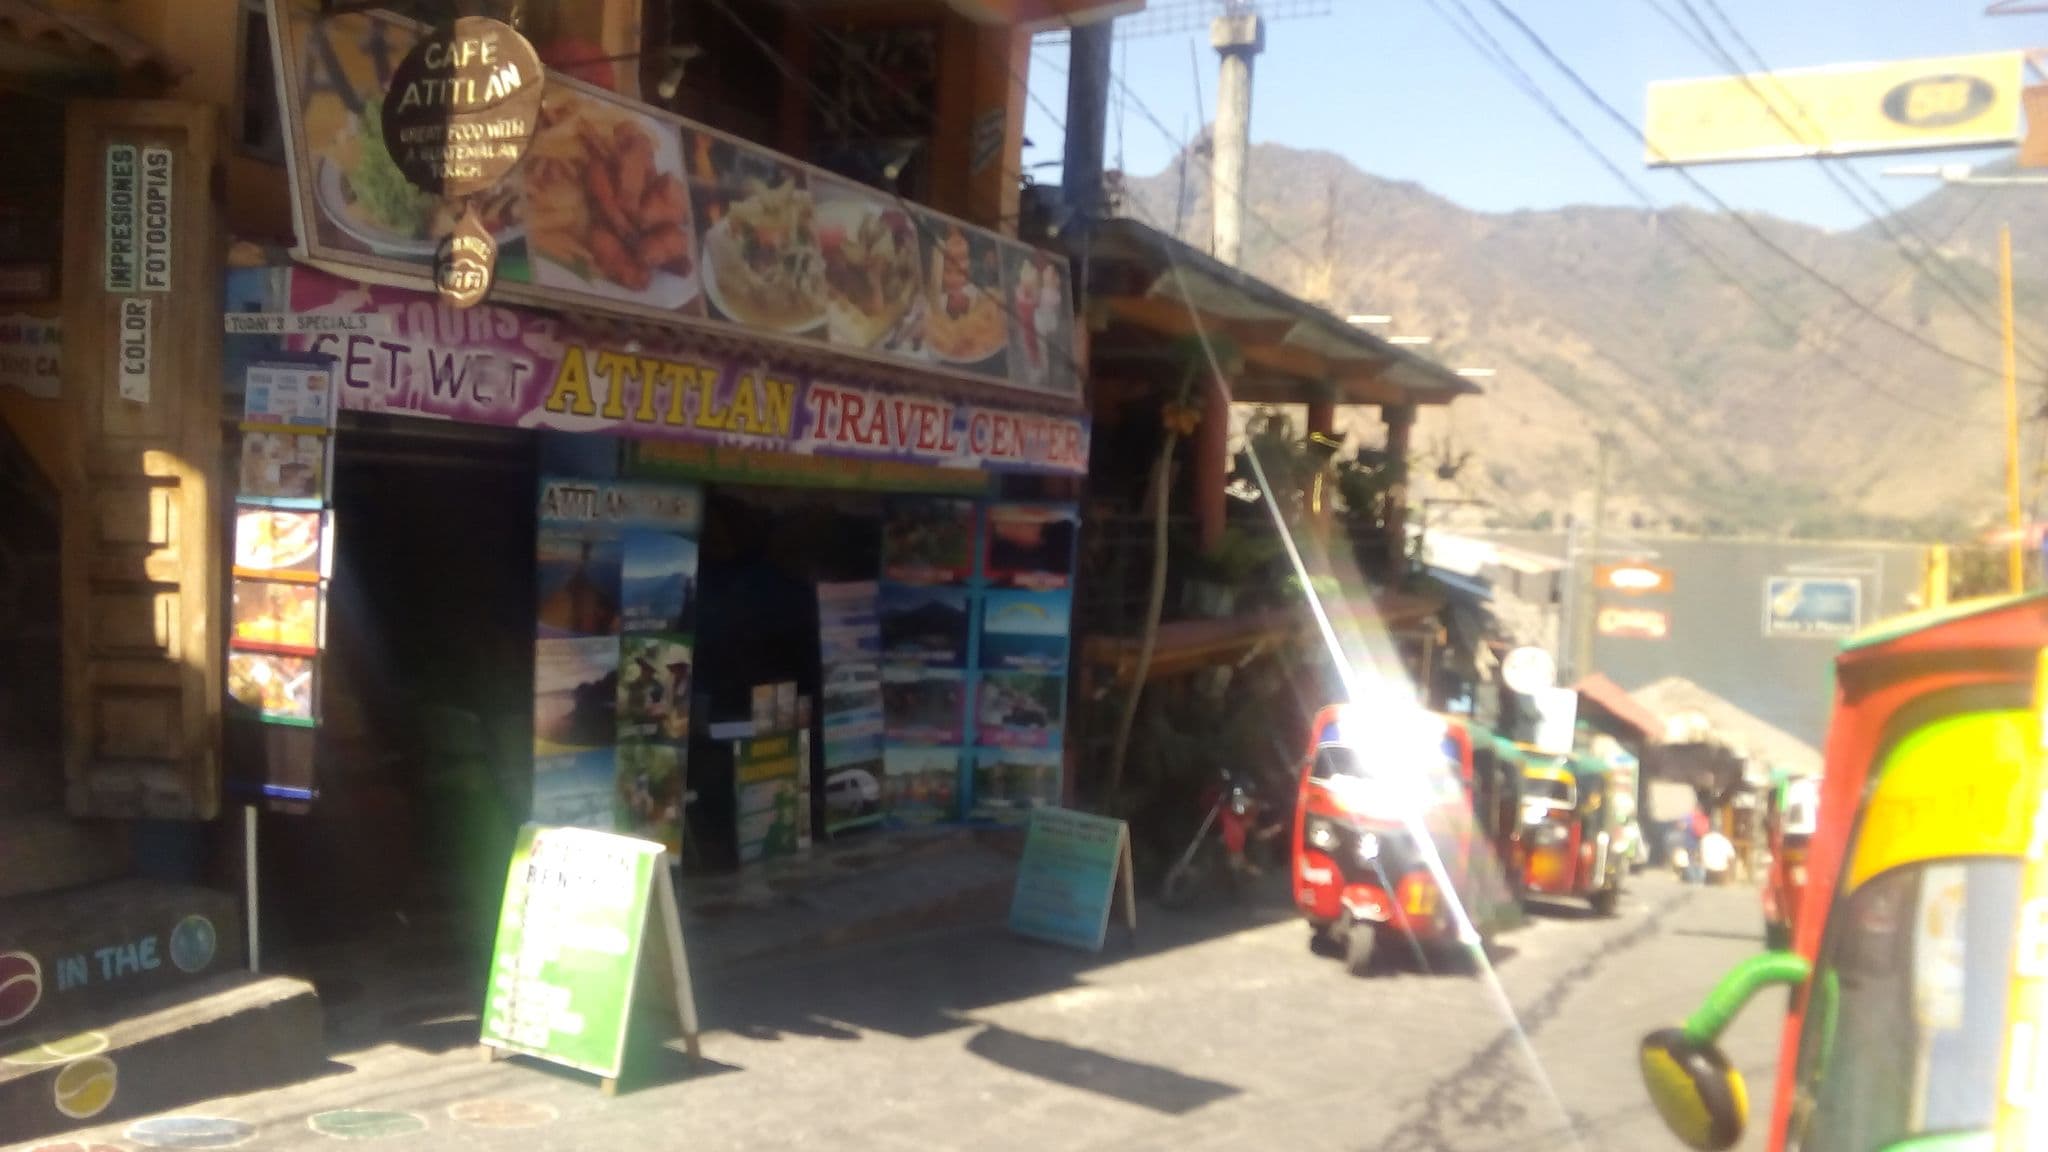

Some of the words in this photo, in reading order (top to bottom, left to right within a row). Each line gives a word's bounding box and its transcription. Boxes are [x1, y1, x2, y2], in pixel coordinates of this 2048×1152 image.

[111, 150, 133, 288] IMPRESIONES
[145, 153, 168, 287] FOTOCOPIAS
[125, 302, 147, 375] COLOR
[298, 314, 368, 332] SPECIALS
[544, 347, 796, 438] ATITLAN
[811, 386, 959, 455] TRAVEL
[968, 413, 1088, 467] CENTER
[57, 954, 88, 991] IN
[95, 936, 162, 980] THE
